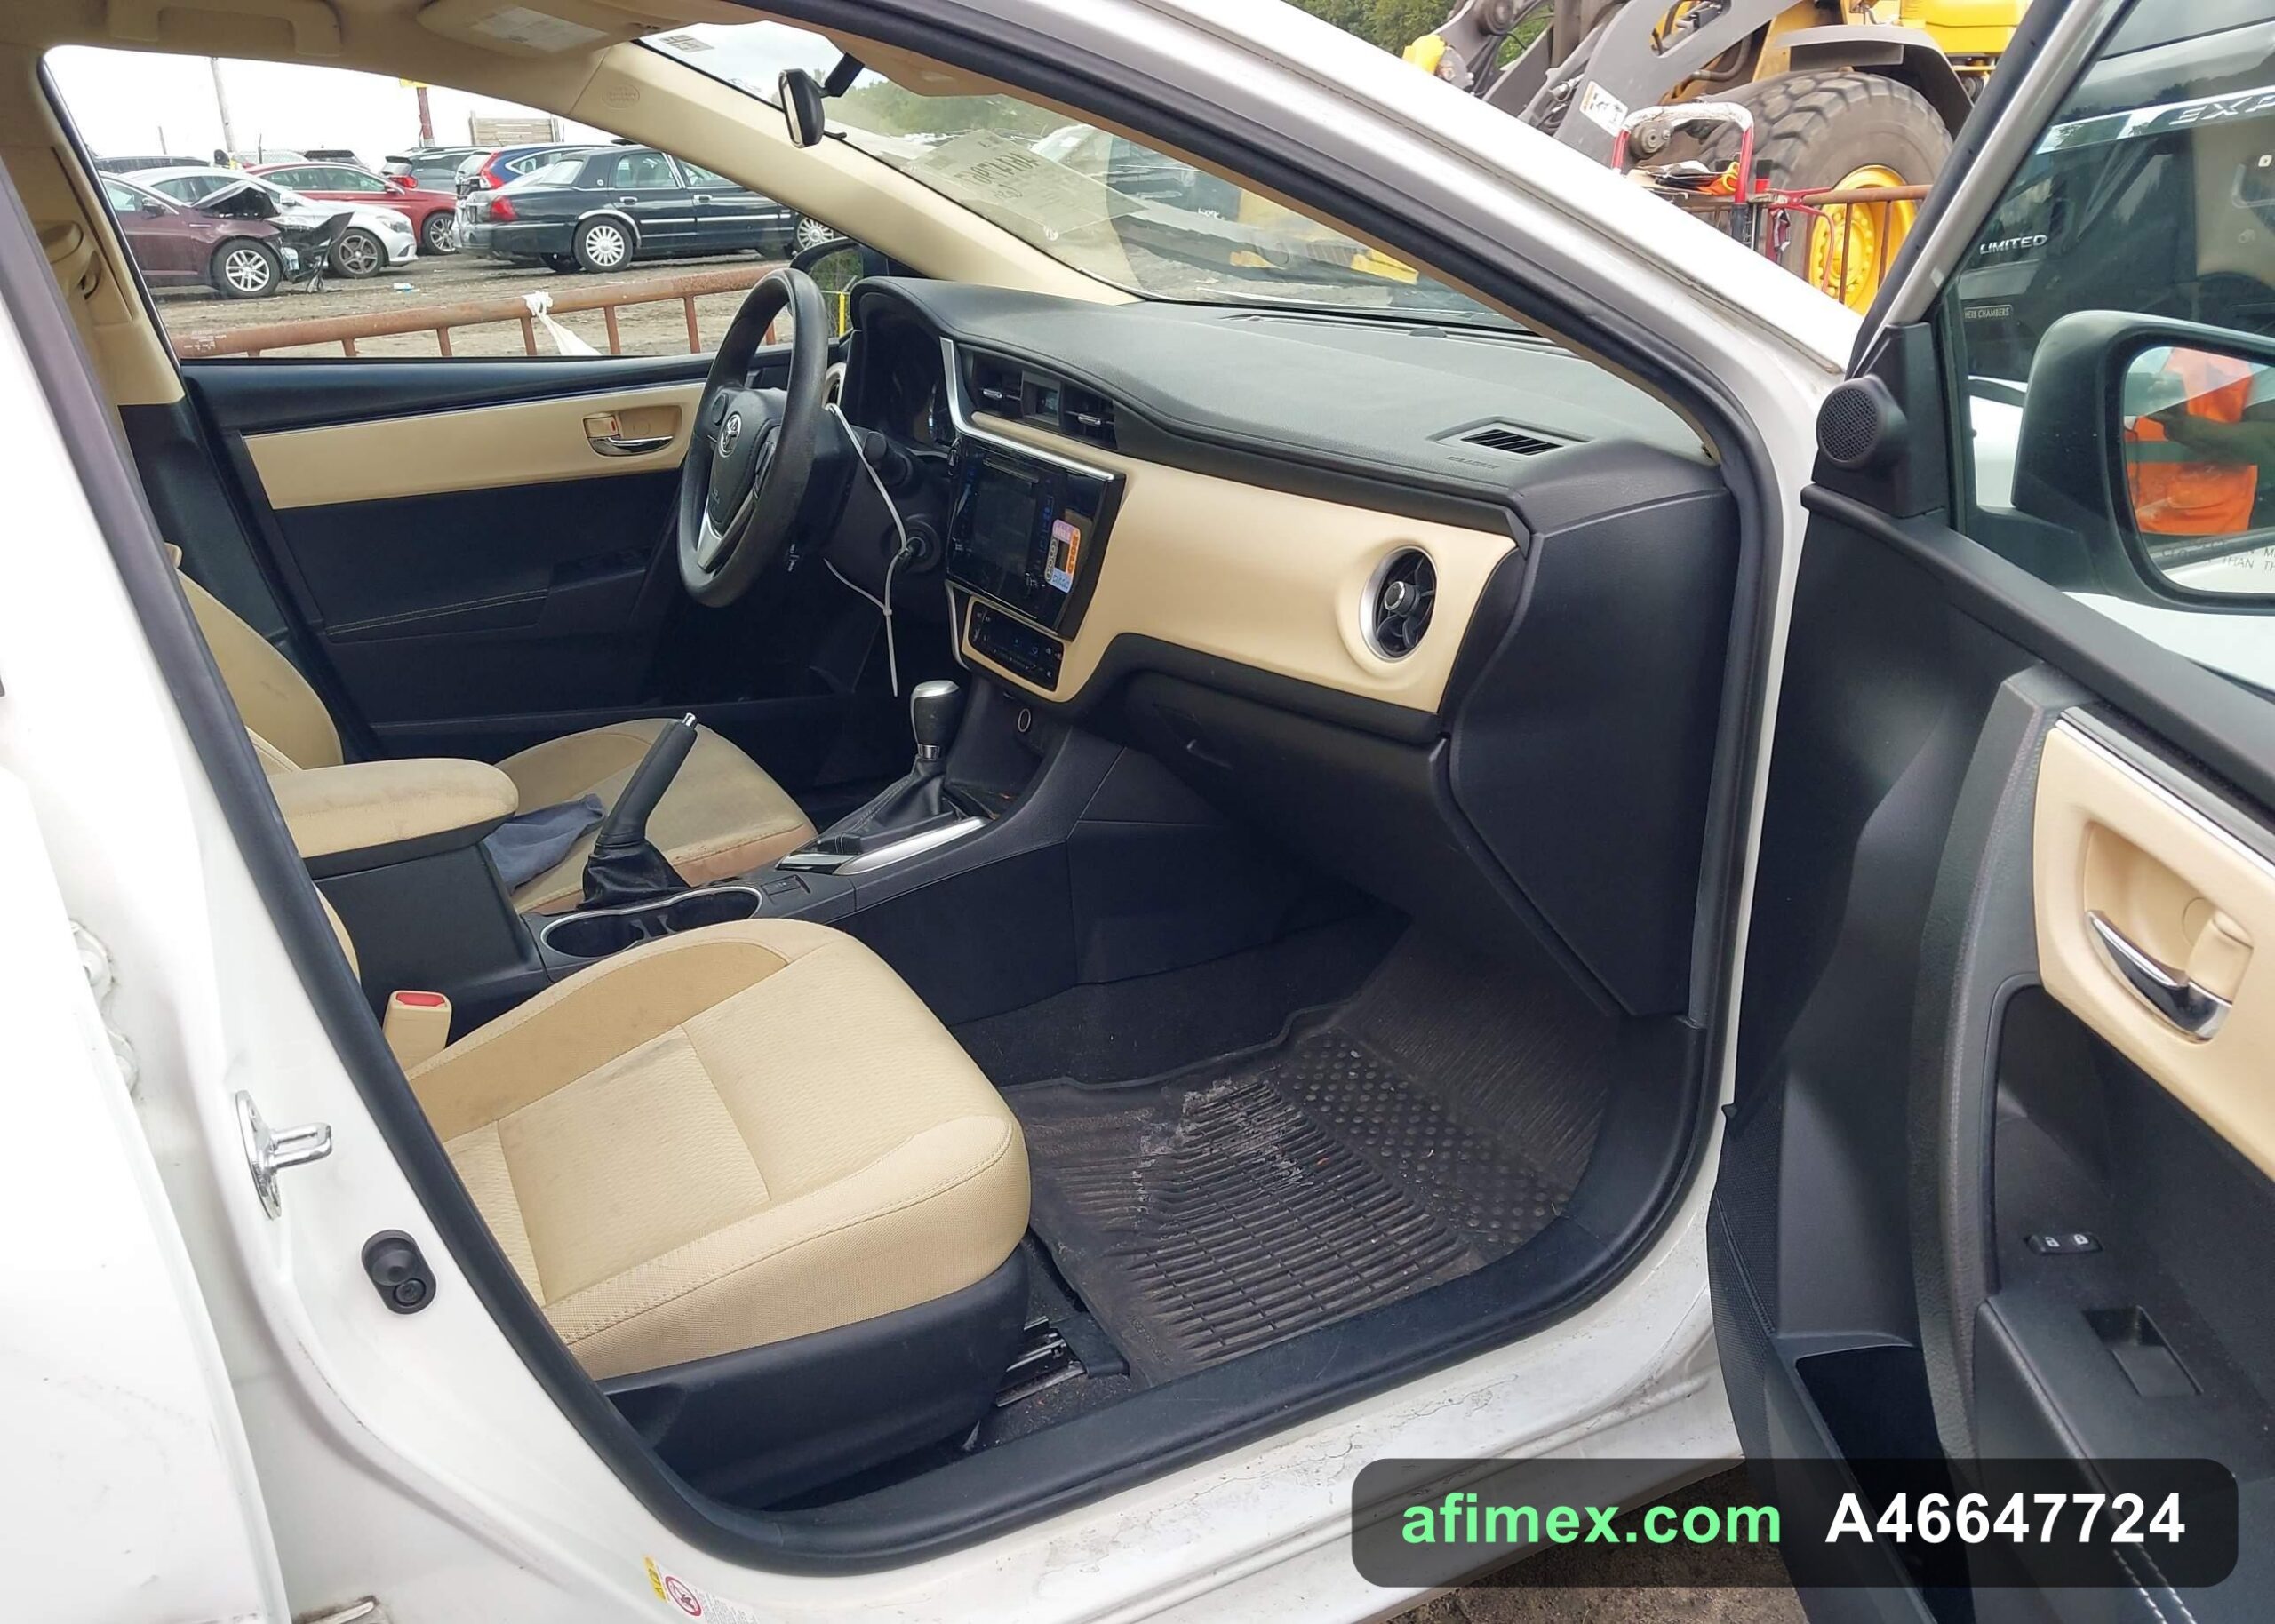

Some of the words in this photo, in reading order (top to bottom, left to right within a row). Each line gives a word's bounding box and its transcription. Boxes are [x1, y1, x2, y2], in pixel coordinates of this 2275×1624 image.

[1979, 234, 2048, 255] LIMITED
[1977, 307, 2009, 318] CHAMBERS
[2222, 556, 2255, 569] THAN
